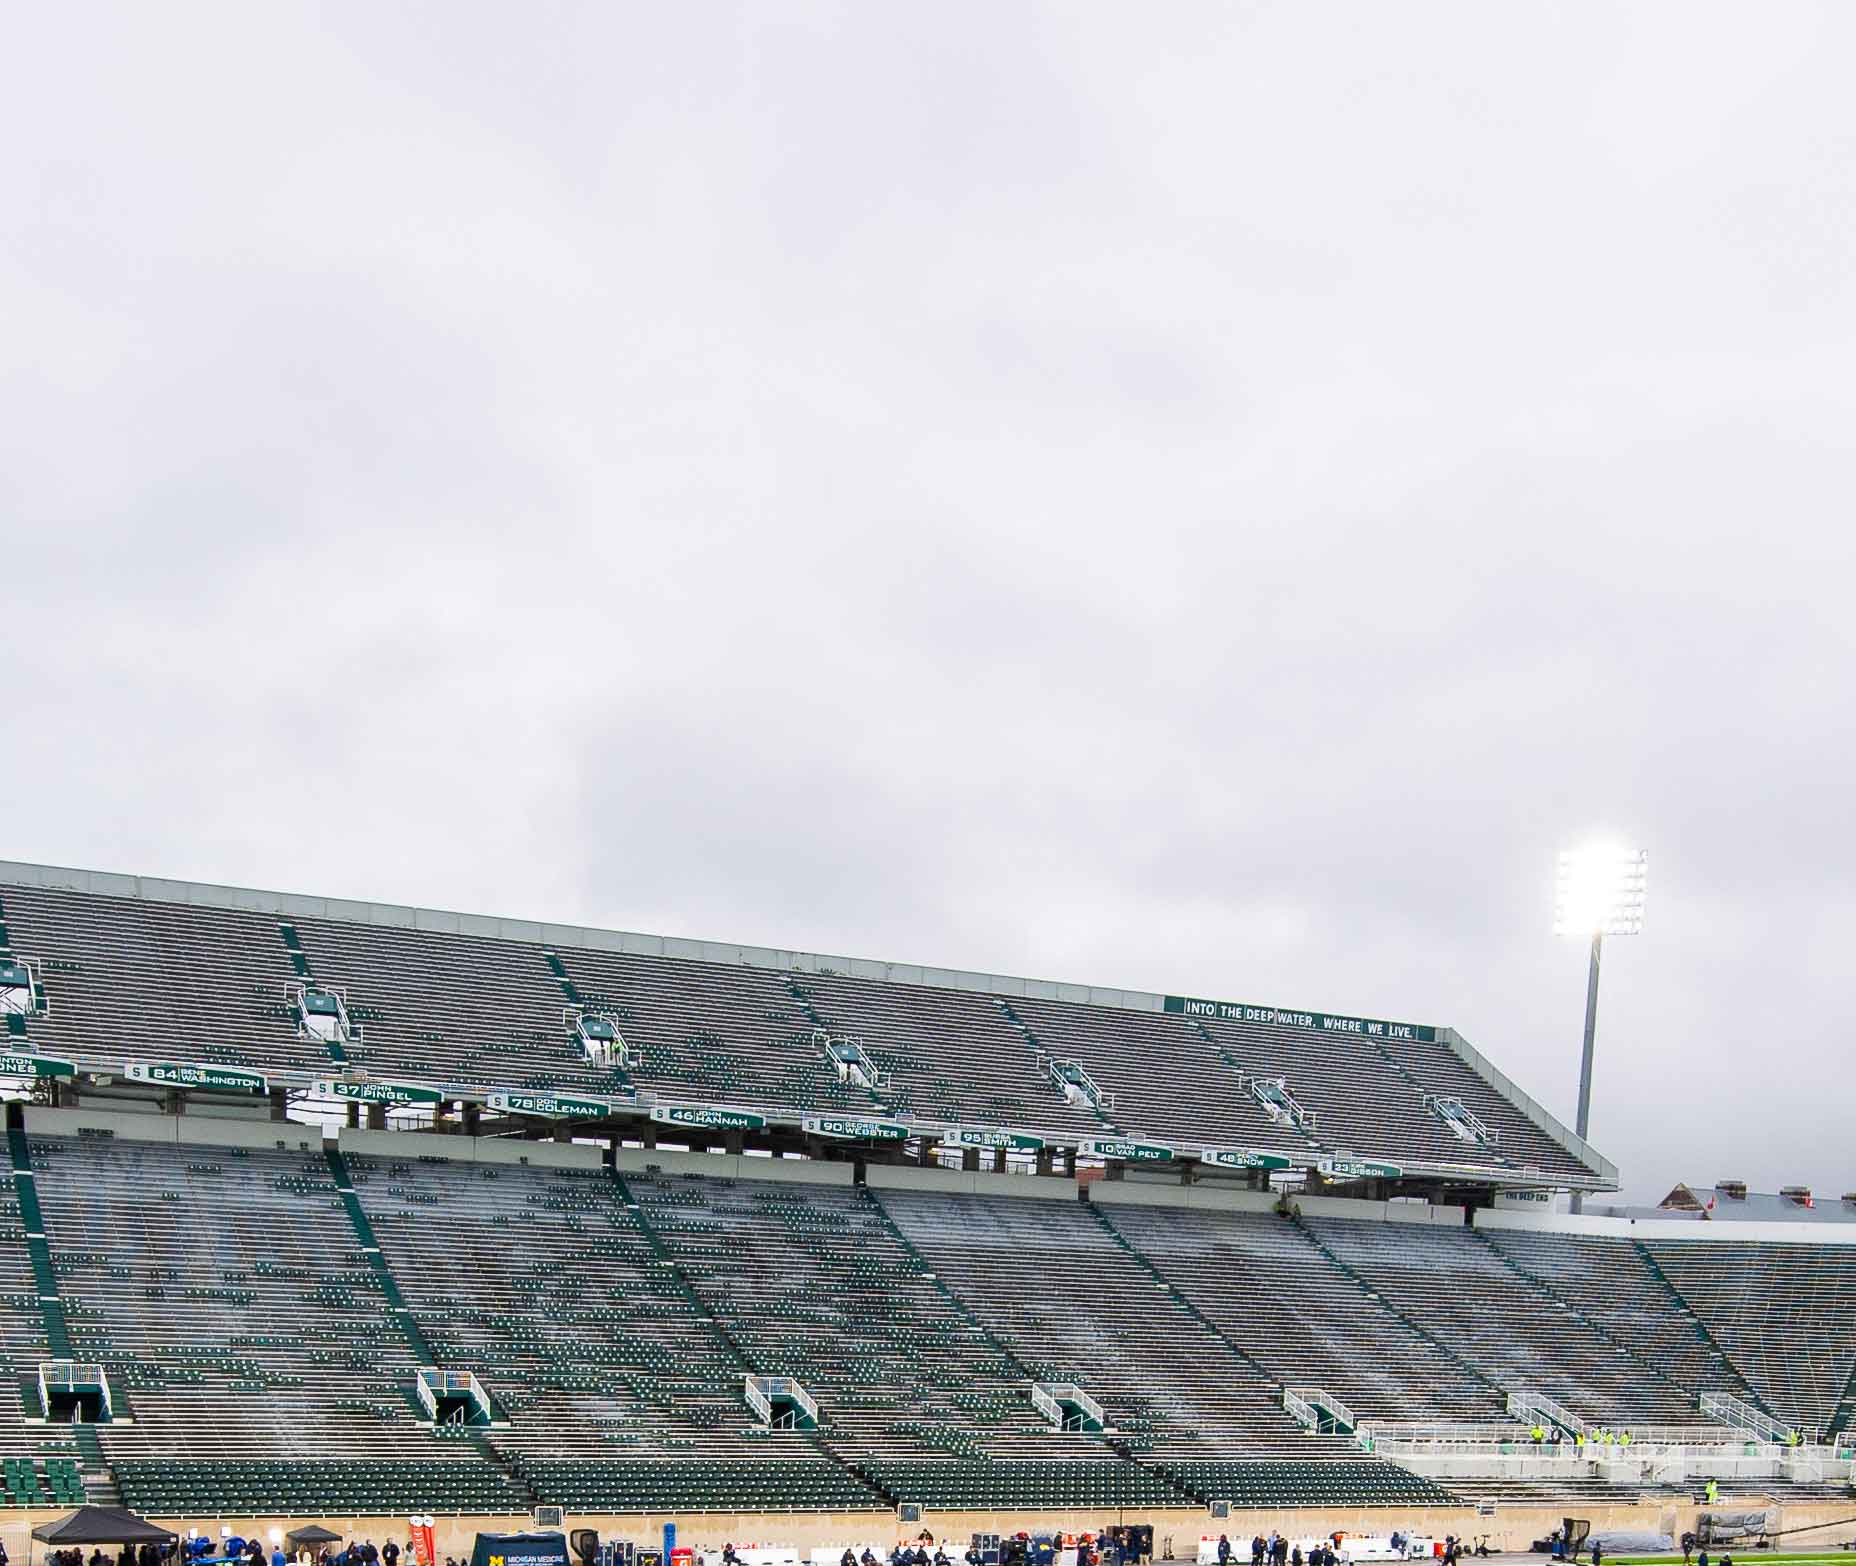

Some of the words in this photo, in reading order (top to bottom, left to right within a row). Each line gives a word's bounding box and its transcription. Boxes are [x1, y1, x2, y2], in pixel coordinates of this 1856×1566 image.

[1186, 1000, 1215, 1016] INTO
[1220, 1005, 1243, 1019] THE
[1246, 1007, 1274, 1023] DEEP
[1277, 1011, 1317, 1028] WATER.
[1323, 1017, 1362, 1033] WHERE
[1367, 1022, 1383, 1035] WE
[153, 1067, 177, 1080] 84
[180, 1073, 261, 1088] WASHINGTON
[337, 1083, 360, 1096] 37
[362, 1083, 392, 1093] JOHN
[362, 1090, 413, 1101] PINGEL
[511, 1097, 534, 1109] 78
[535, 1103, 598, 1115] COLEMAN
[673, 1110, 694, 1121] 46
[695, 1115, 748, 1126] HANNAH
[823, 1121, 842, 1132] 90
[845, 1127, 898, 1138] WEBSTER
[963, 1133, 981, 1143] 95
[984, 1138, 1017, 1147] SMITH
[507, 1555, 537, 1564] MICHIGAN
